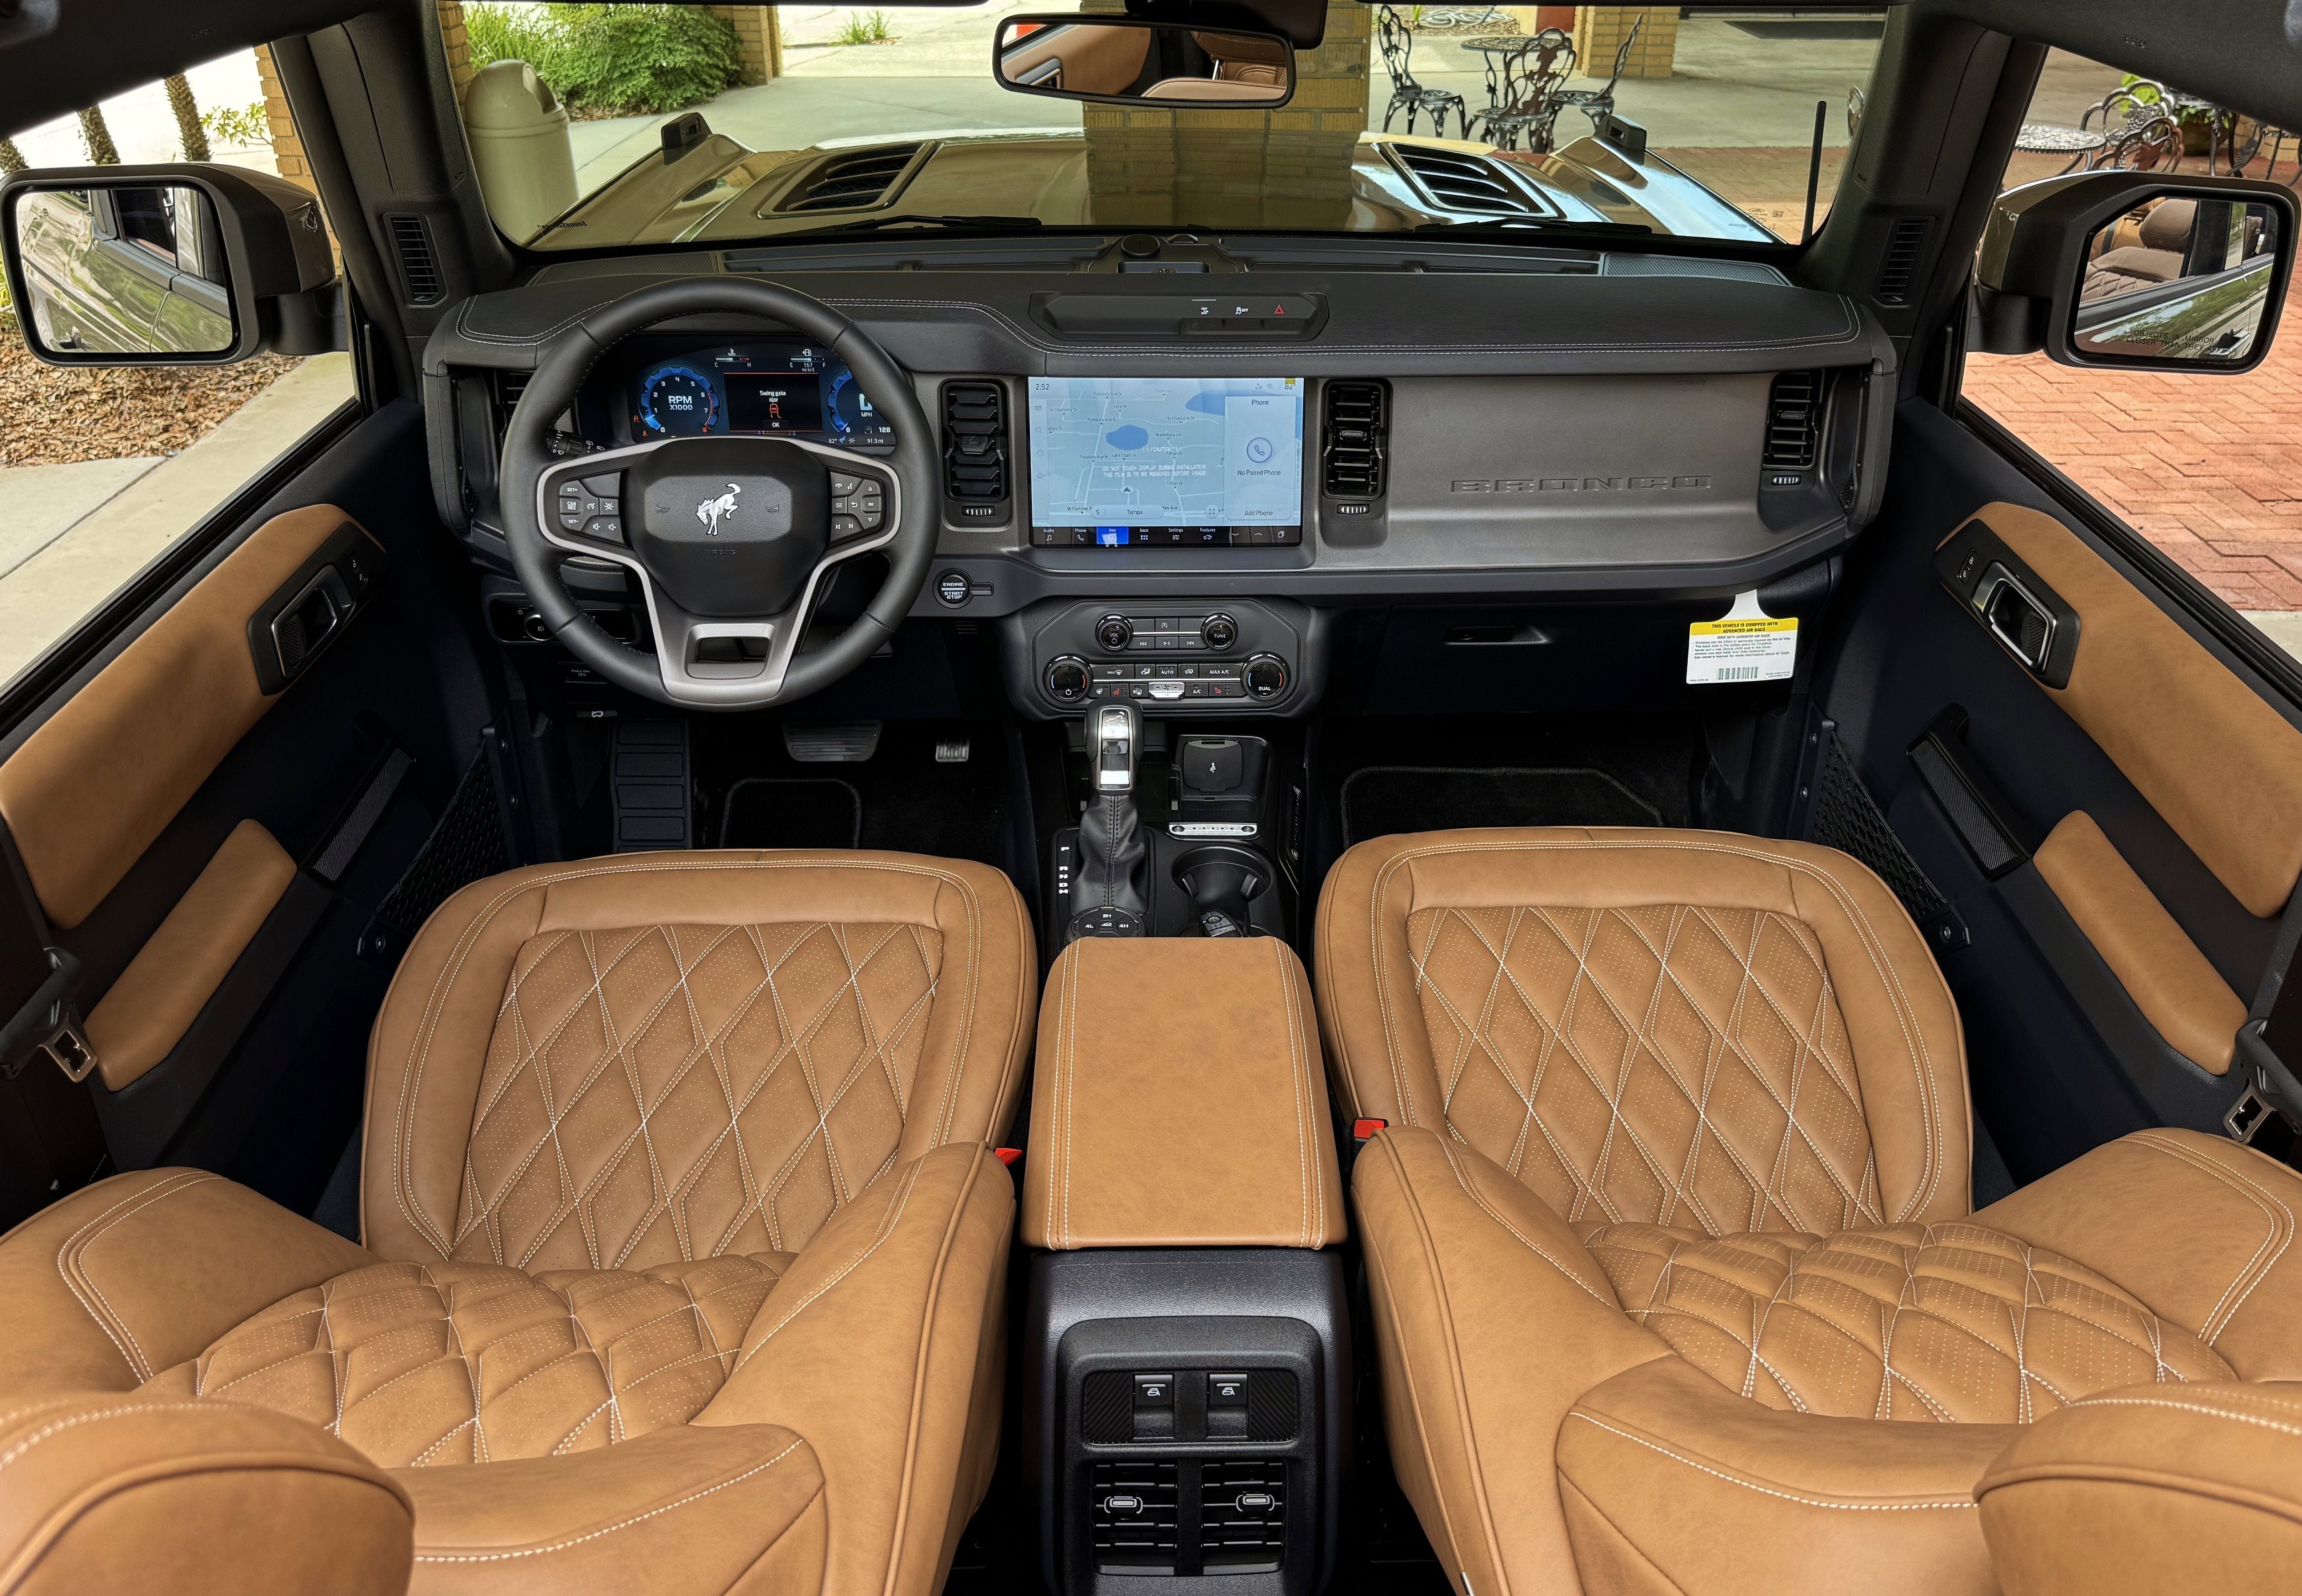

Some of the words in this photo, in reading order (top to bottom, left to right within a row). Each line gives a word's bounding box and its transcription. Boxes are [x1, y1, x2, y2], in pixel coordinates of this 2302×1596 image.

[2134, 330, 2168, 339] OBJECTS
[2127, 337, 2155, 345] CLOSER
[668, 396, 692, 404] RPM
[1450, 475, 1711, 494] BRONCO
